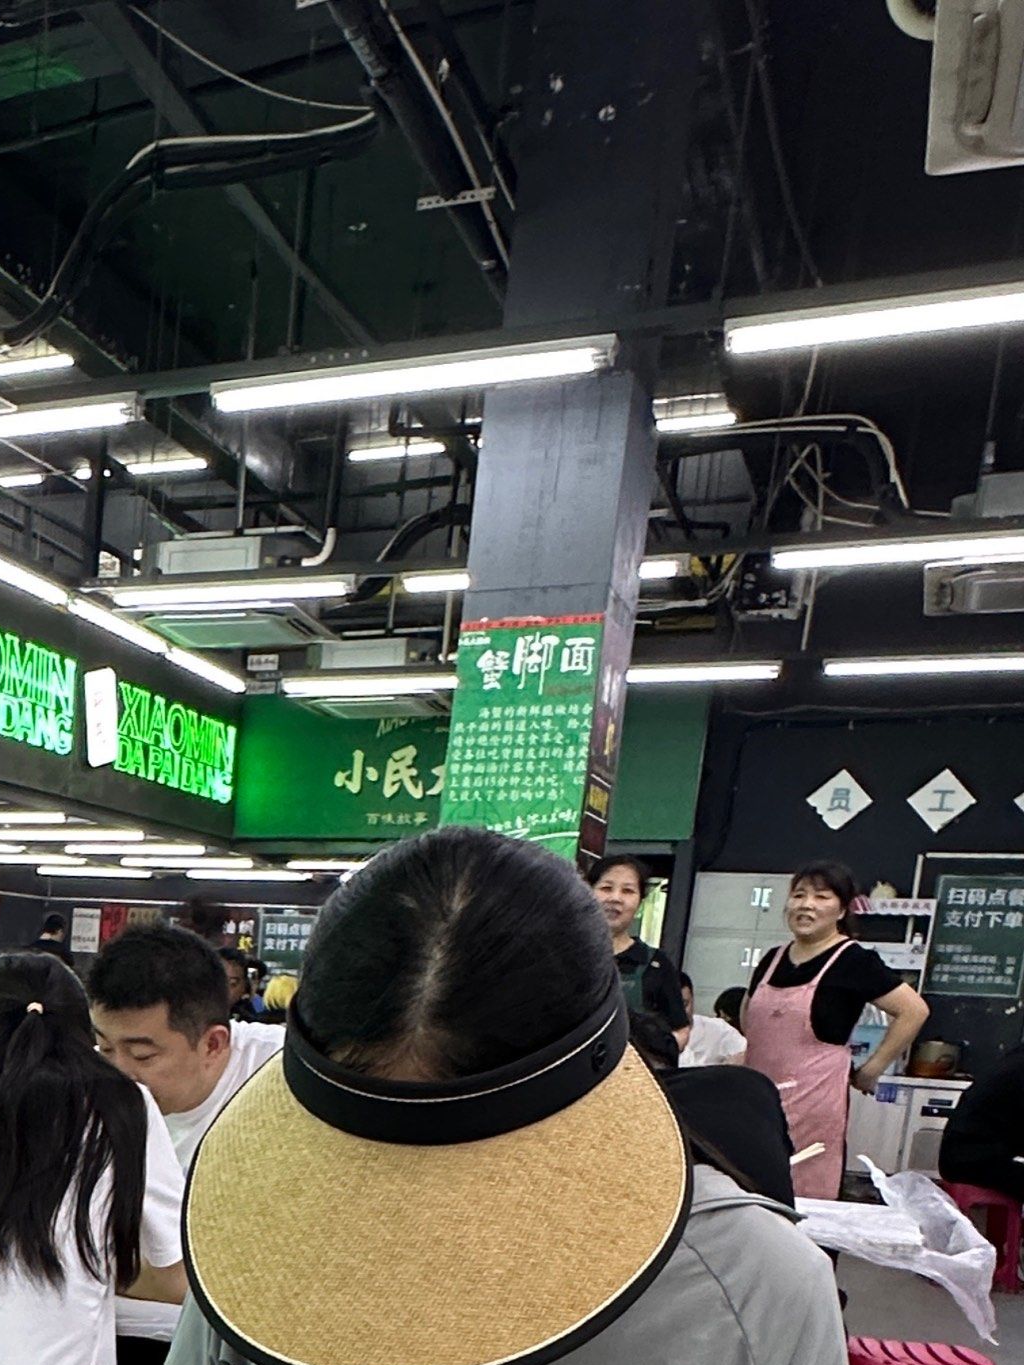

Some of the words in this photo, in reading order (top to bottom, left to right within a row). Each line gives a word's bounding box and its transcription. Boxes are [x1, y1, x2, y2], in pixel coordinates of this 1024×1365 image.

[117, 680, 237, 775] XIAOMIN
[113, 734, 147, 779] DA
[147, 745, 180, 789] PAI
[943, 911, 1024, 929] 支付下单
